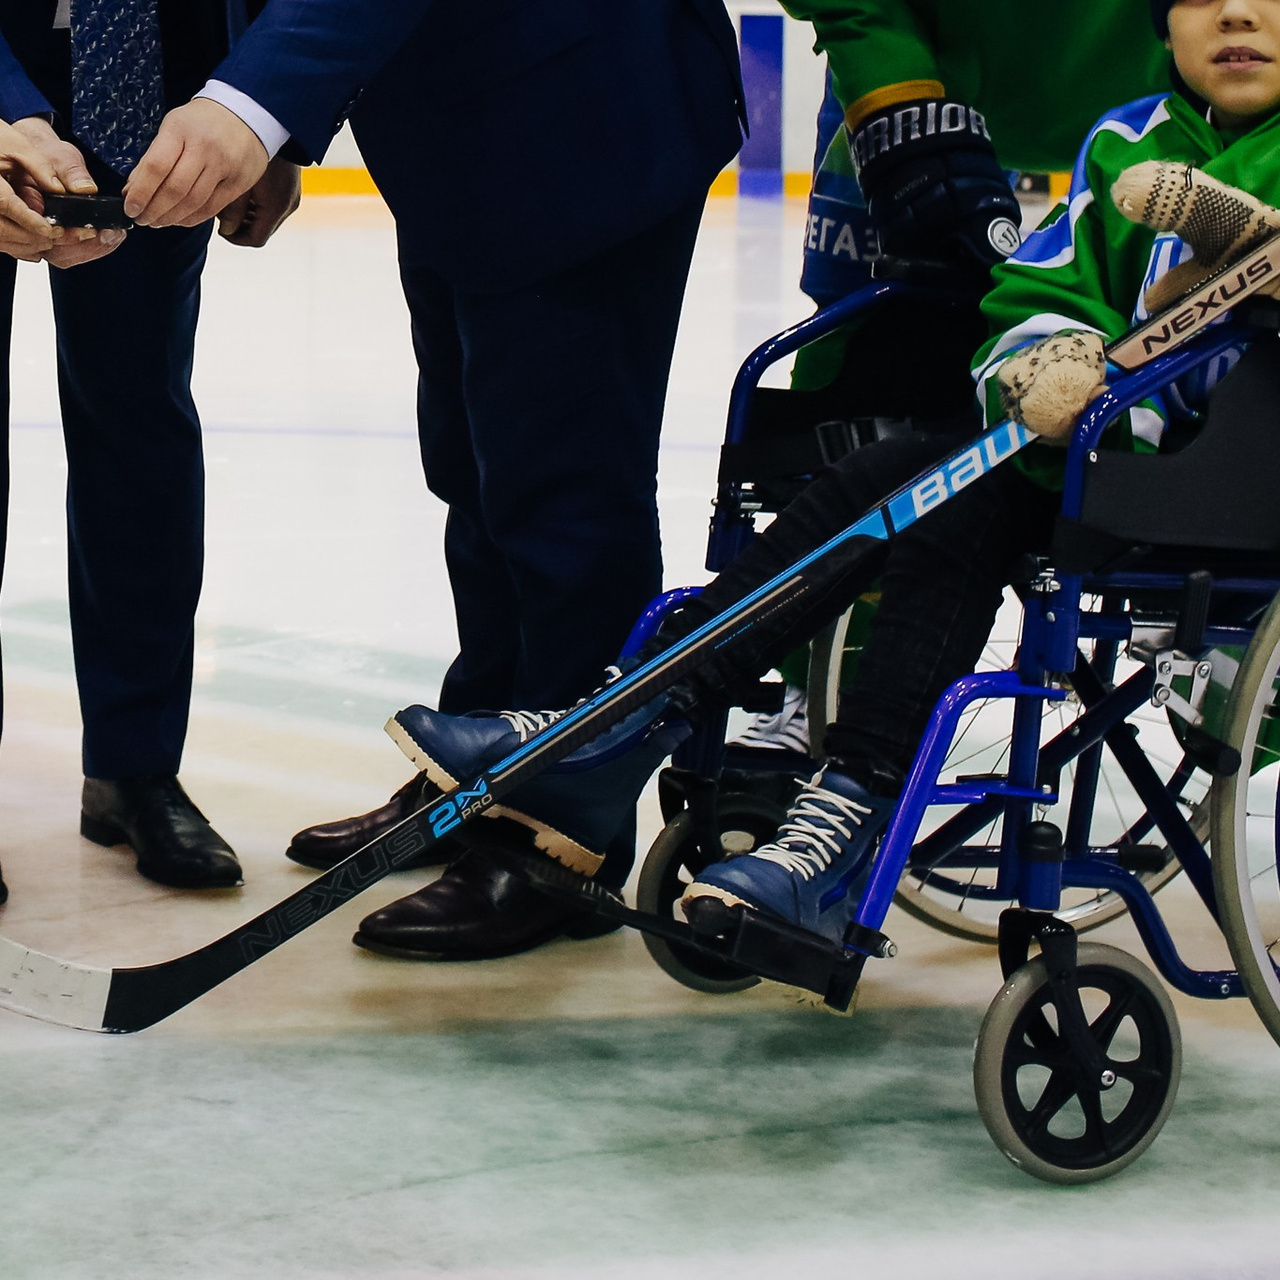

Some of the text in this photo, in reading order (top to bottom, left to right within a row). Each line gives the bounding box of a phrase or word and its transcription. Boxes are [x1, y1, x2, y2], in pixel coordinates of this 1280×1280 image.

[851, 102, 991, 172] ARRIOR
[1141, 255, 1273, 355] NEXUS
[461, 793, 493, 819] PRO
[238, 819, 426, 963] NEXUS
